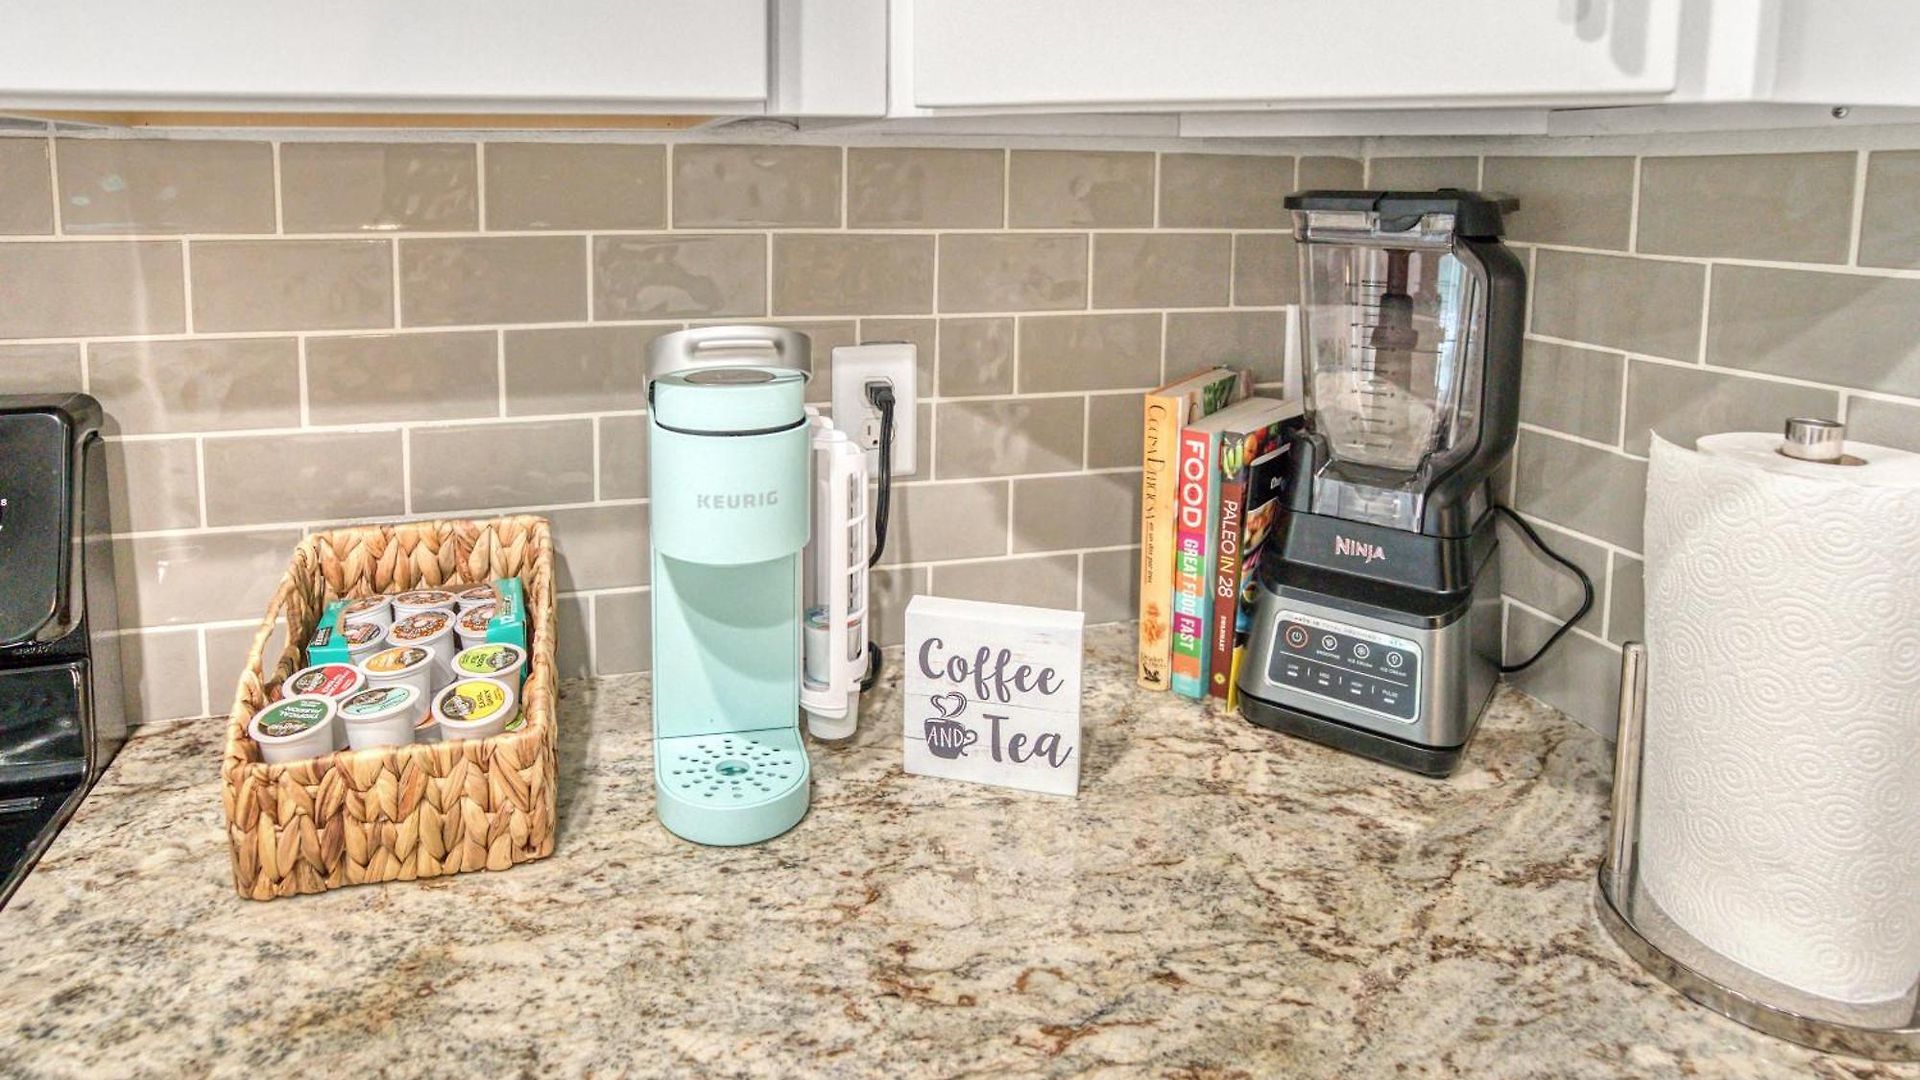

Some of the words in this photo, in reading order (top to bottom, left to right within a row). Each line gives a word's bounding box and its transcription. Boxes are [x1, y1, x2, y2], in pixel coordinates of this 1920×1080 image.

[697, 490, 779, 509] KEURIG
[1182, 440, 1206, 528] FOOD
[1220, 500, 1239, 554] PALEO
[1182, 538, 1199, 580] GREAT
[1220, 556, 1235, 574] IN
[1335, 535, 1386, 563] NINJA
[1181, 582, 1197, 615] FOOD
[1217, 576, 1234, 598] 28
[1180, 617, 1195, 650] FAST
[919, 637, 1064, 703] Coffee
[927, 727, 964, 748] AND
[983, 713, 1073, 769] Tea
